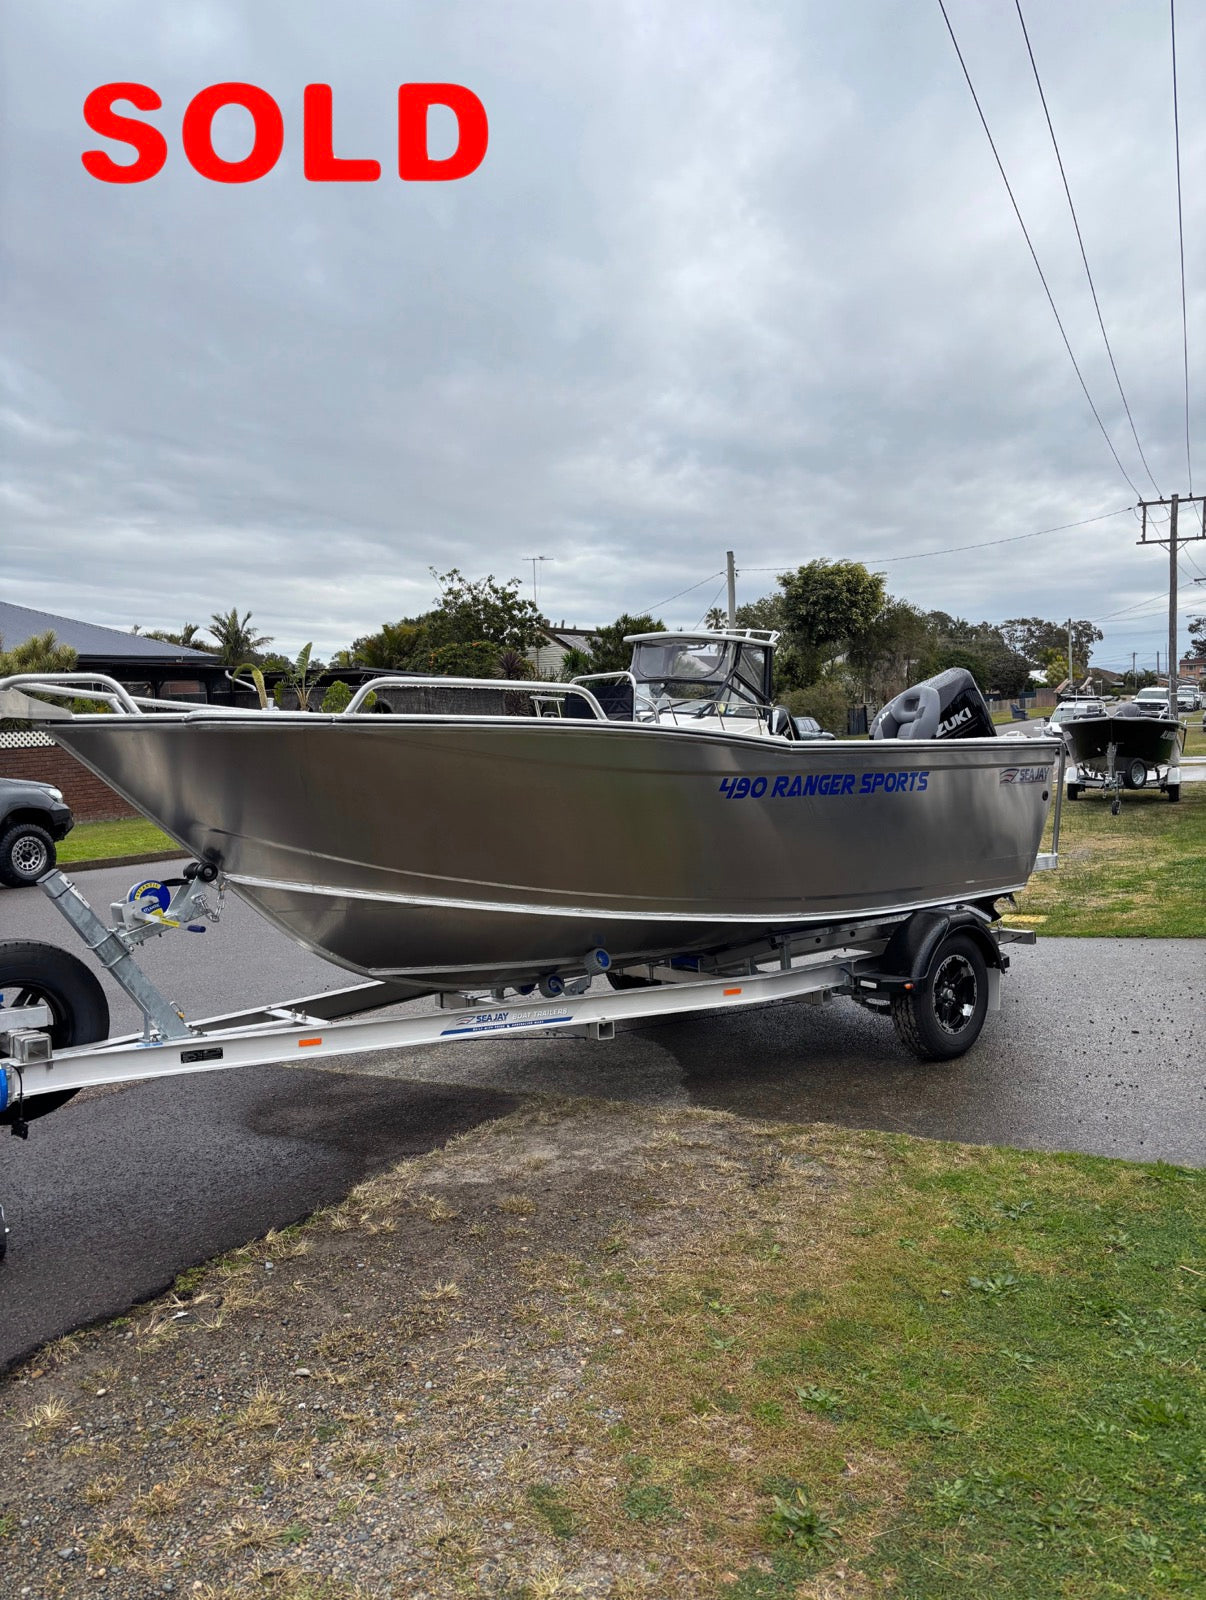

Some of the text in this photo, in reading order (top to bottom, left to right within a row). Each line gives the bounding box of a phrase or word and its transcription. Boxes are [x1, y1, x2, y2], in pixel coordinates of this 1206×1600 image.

[719, 771, 930, 799] 490 RANGER SPORTS
